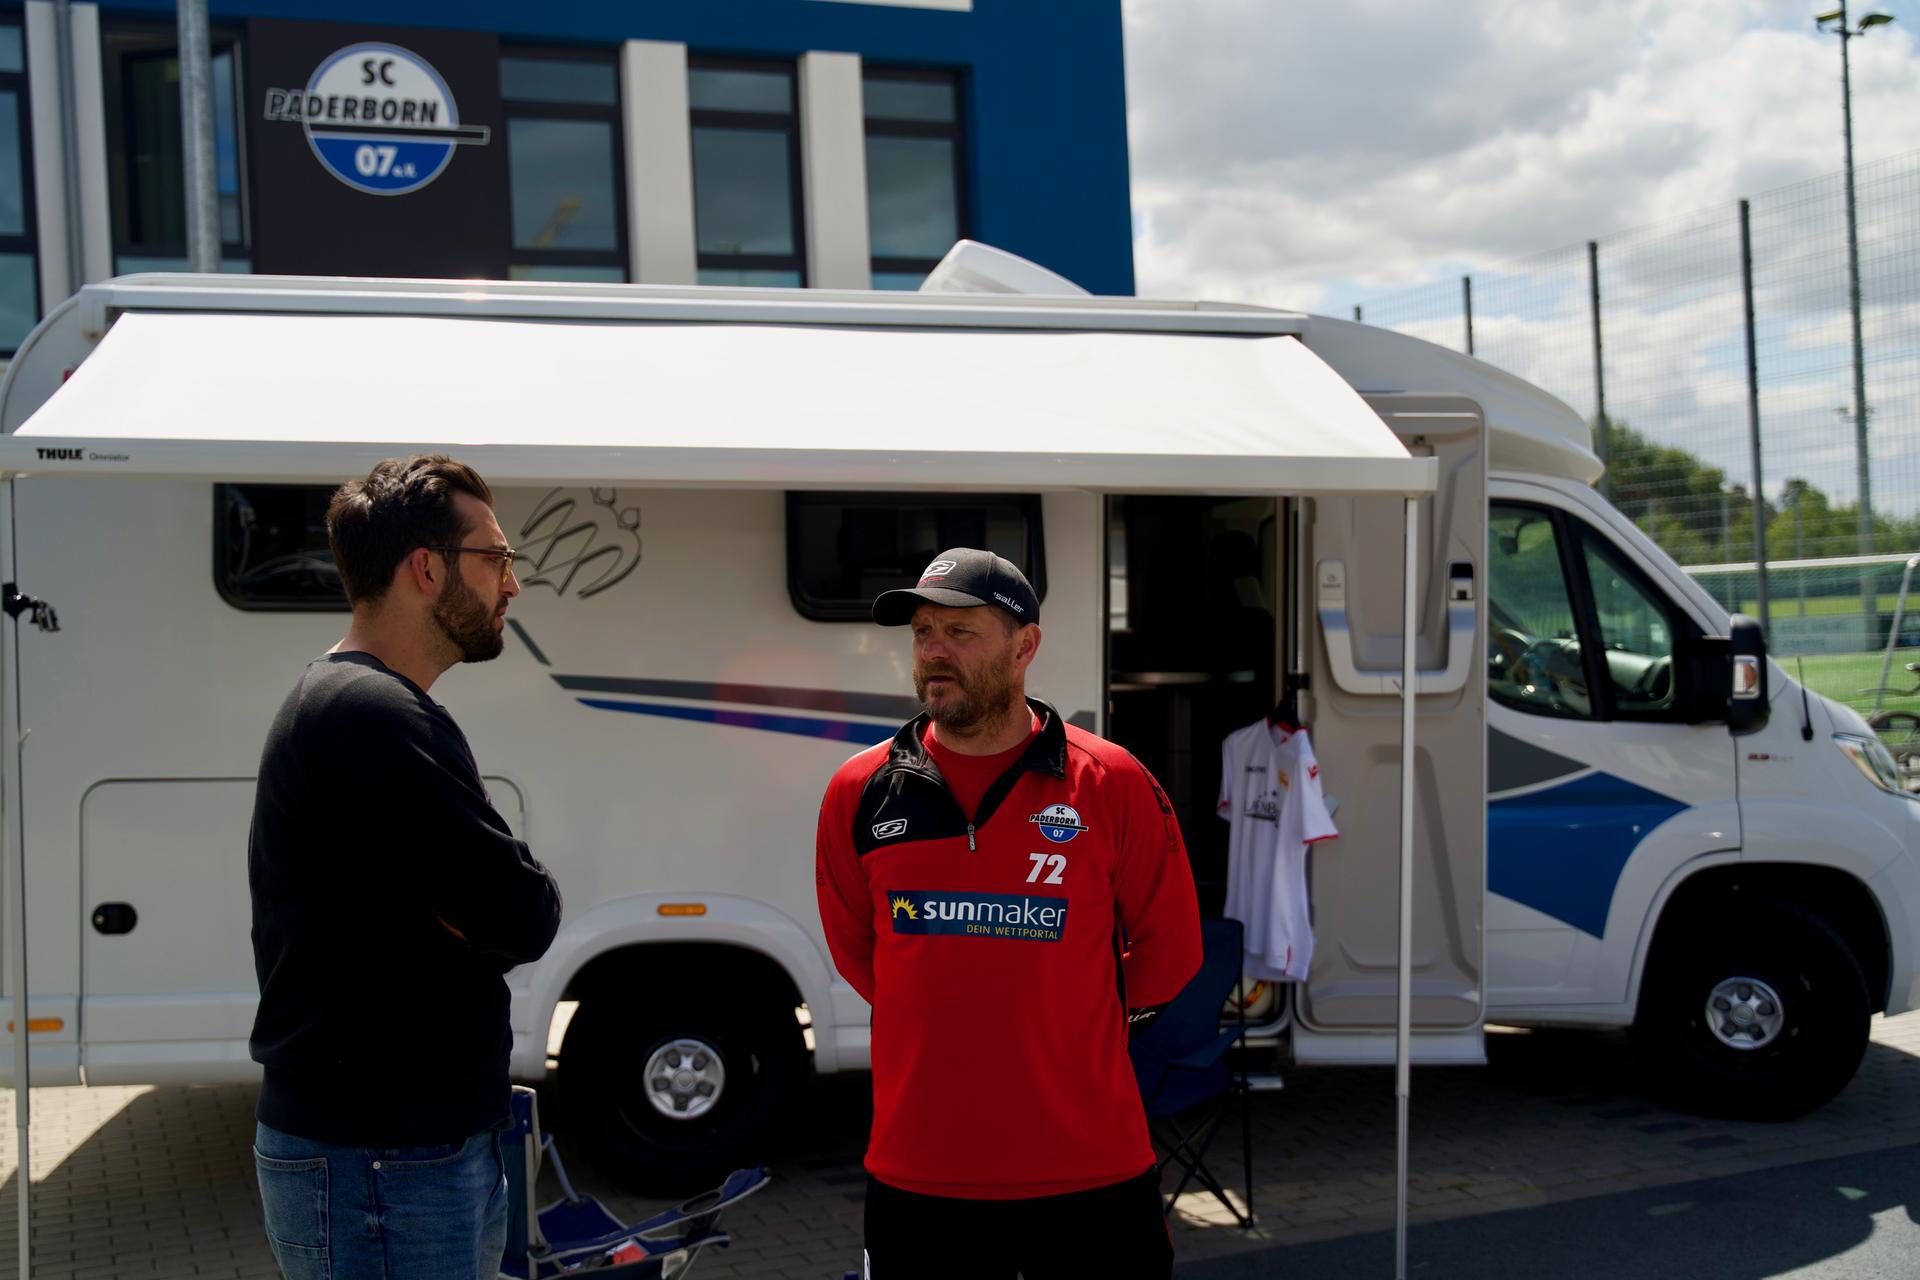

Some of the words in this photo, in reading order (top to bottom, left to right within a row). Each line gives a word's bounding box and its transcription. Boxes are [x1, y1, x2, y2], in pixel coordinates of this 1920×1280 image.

[361, 59, 396, 87] SC
[268, 92, 439, 124] PADERBORN
[354, 144, 399, 177] 07
[36, 447, 83, 460] THULE
[1029, 814, 1077, 826] PADERBORN
[1055, 807, 1066, 815] SC
[1052, 829, 1065, 838] 07
[1025, 852, 1067, 885] 72
[923, 898, 1066, 928] sunmaker
[966, 923, 991, 934] DEIN
[995, 926, 1059, 940] WETTPORTAL
